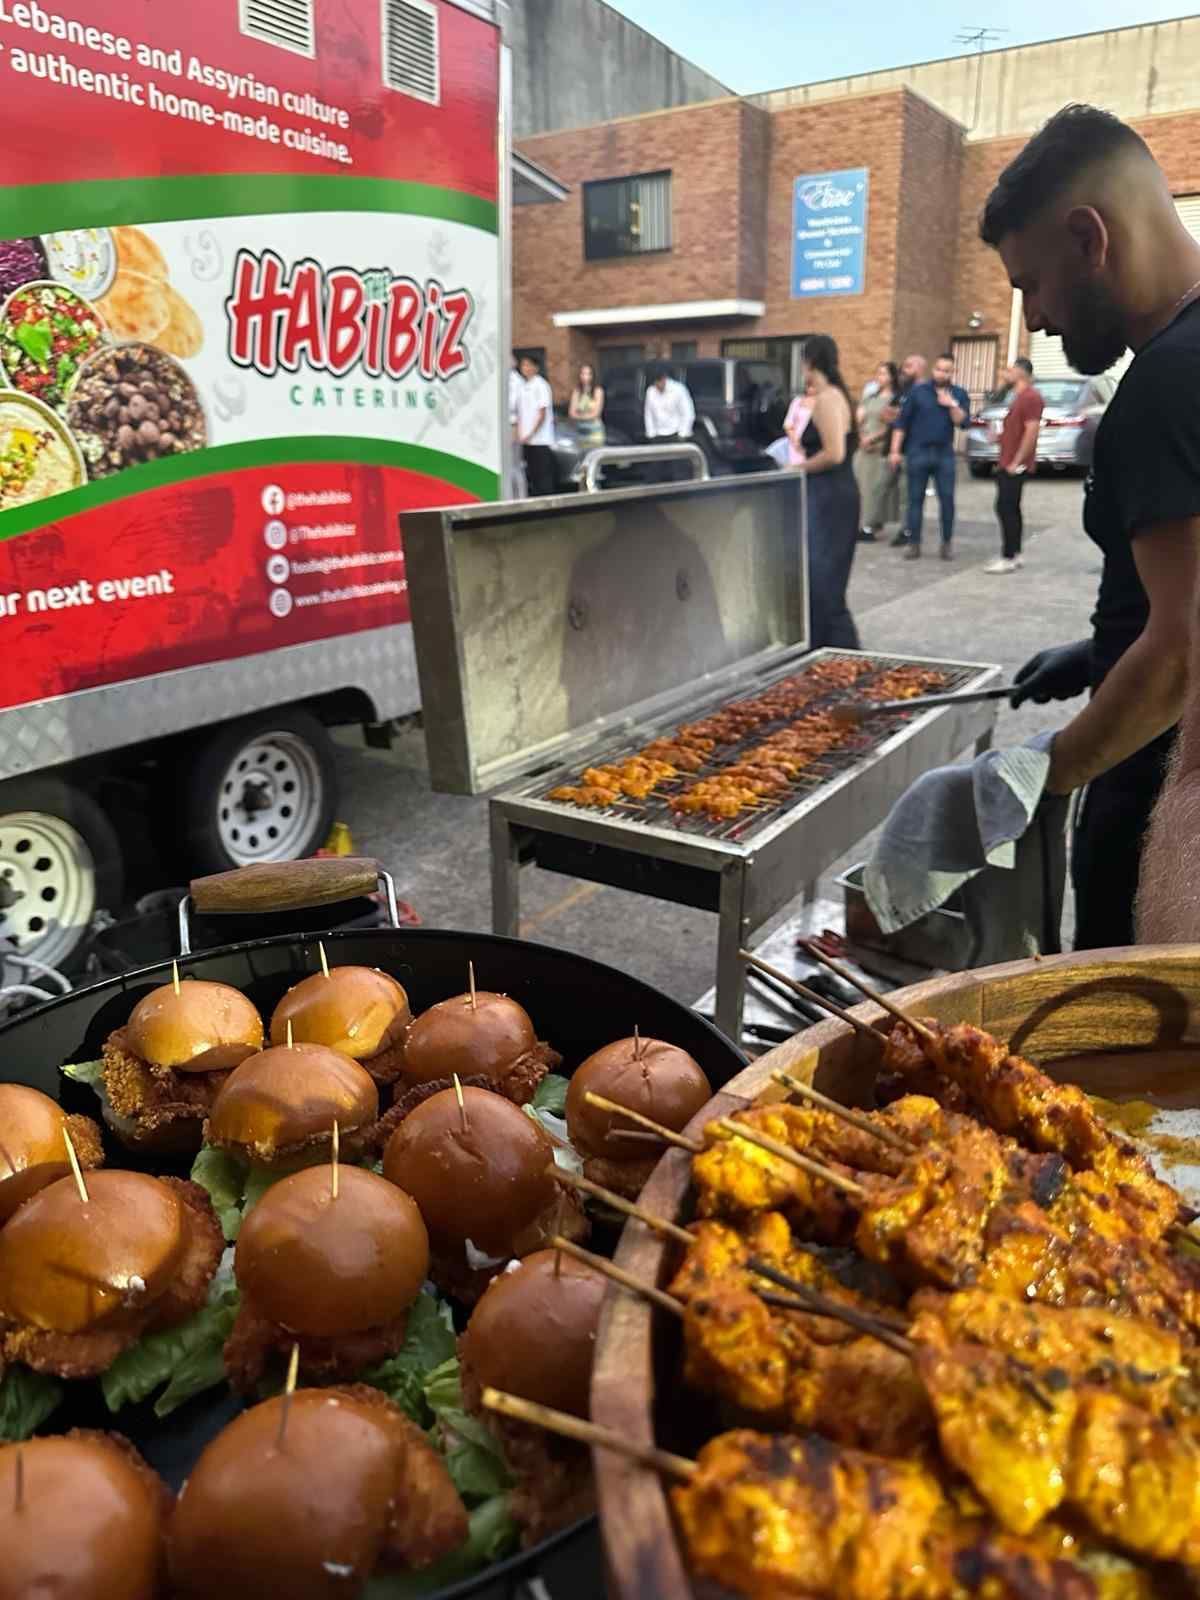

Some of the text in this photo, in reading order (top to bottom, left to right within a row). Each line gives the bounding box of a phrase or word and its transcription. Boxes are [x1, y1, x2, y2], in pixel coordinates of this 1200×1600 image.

[0, 0, 350, 128] Lebanese and Assyrian culture
[10, 48, 353, 164] authentic home-made cuisine.
[290, 385, 437, 409] CATERING
[27, 579, 95, 613] next
[98, 569, 175, 602] event
